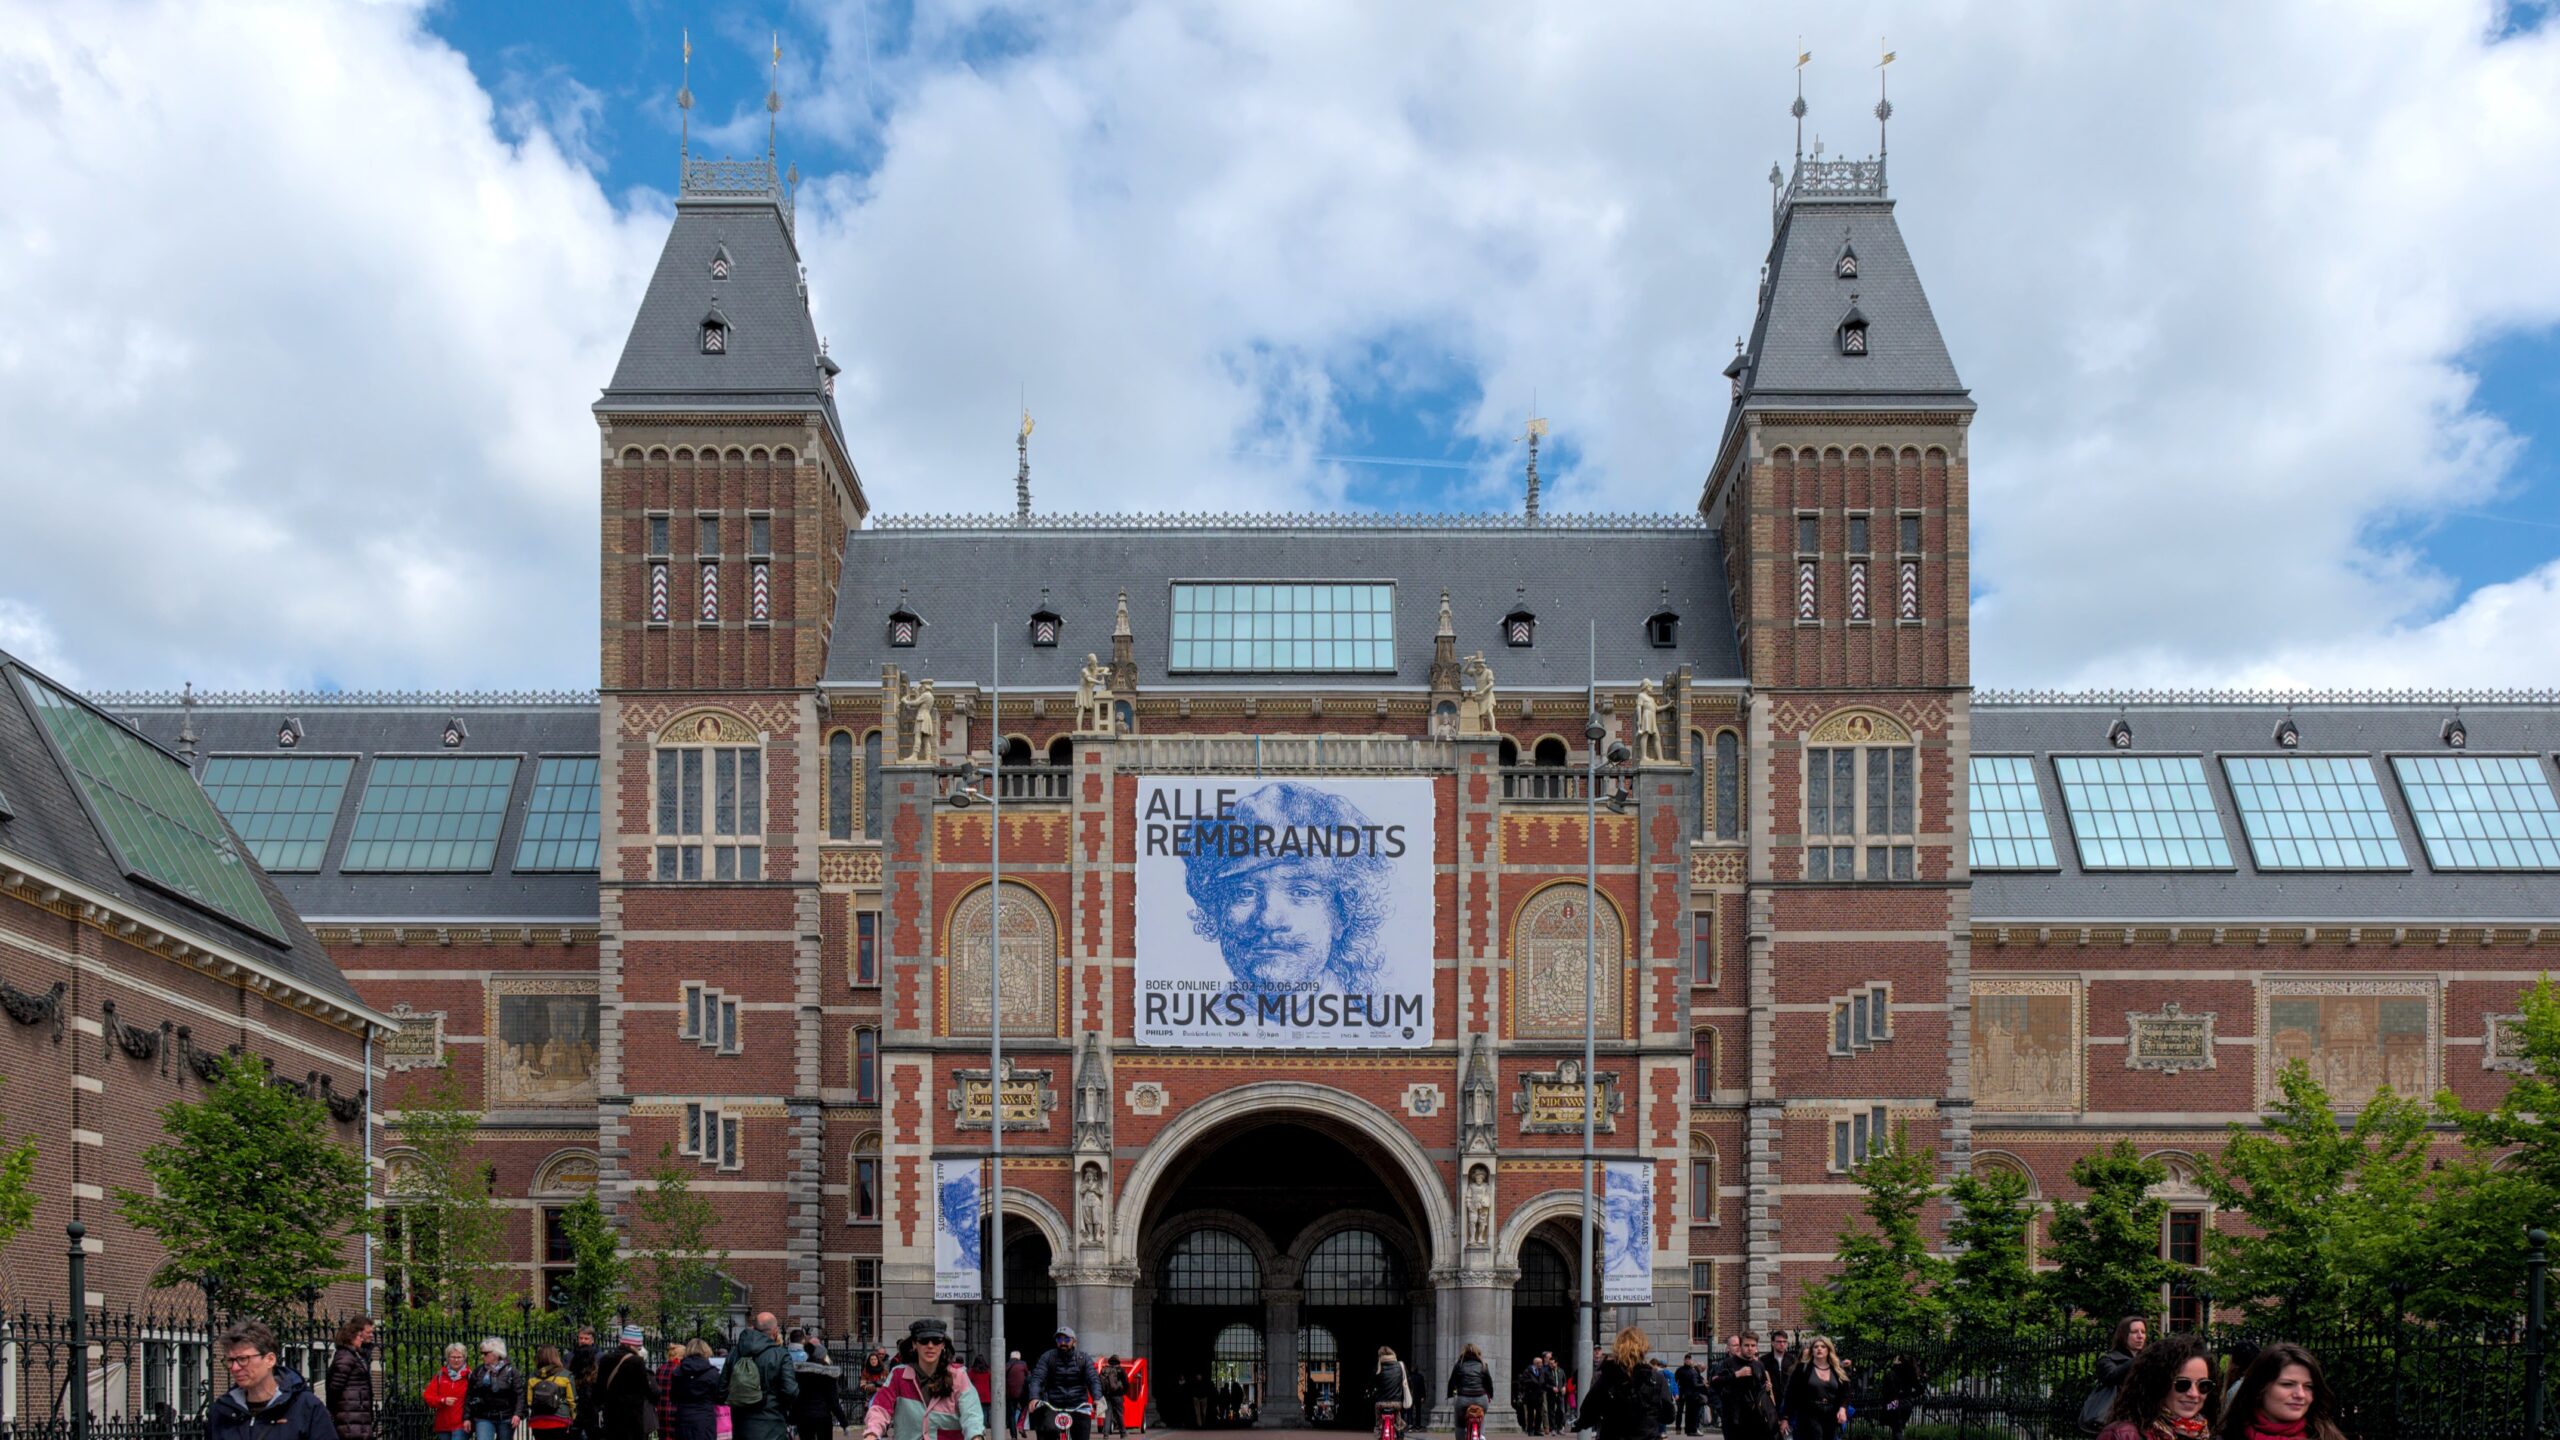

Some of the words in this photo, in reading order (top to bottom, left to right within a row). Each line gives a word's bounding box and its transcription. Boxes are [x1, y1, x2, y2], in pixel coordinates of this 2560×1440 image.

[1145, 788, 1236, 821] ALLE
[1146, 824, 1406, 858] REMBRANDTS
[1145, 980, 1173, 990] BOEK
[1177, 980, 1220, 991] ONLINE!
[1145, 992, 1246, 1026] RIJKS
[1258, 993, 1422, 1027] MUSEUM
[937, 1182, 945, 1232] REMBRANDTS
[1641, 1196, 1649, 1245] REMBRANDTS
